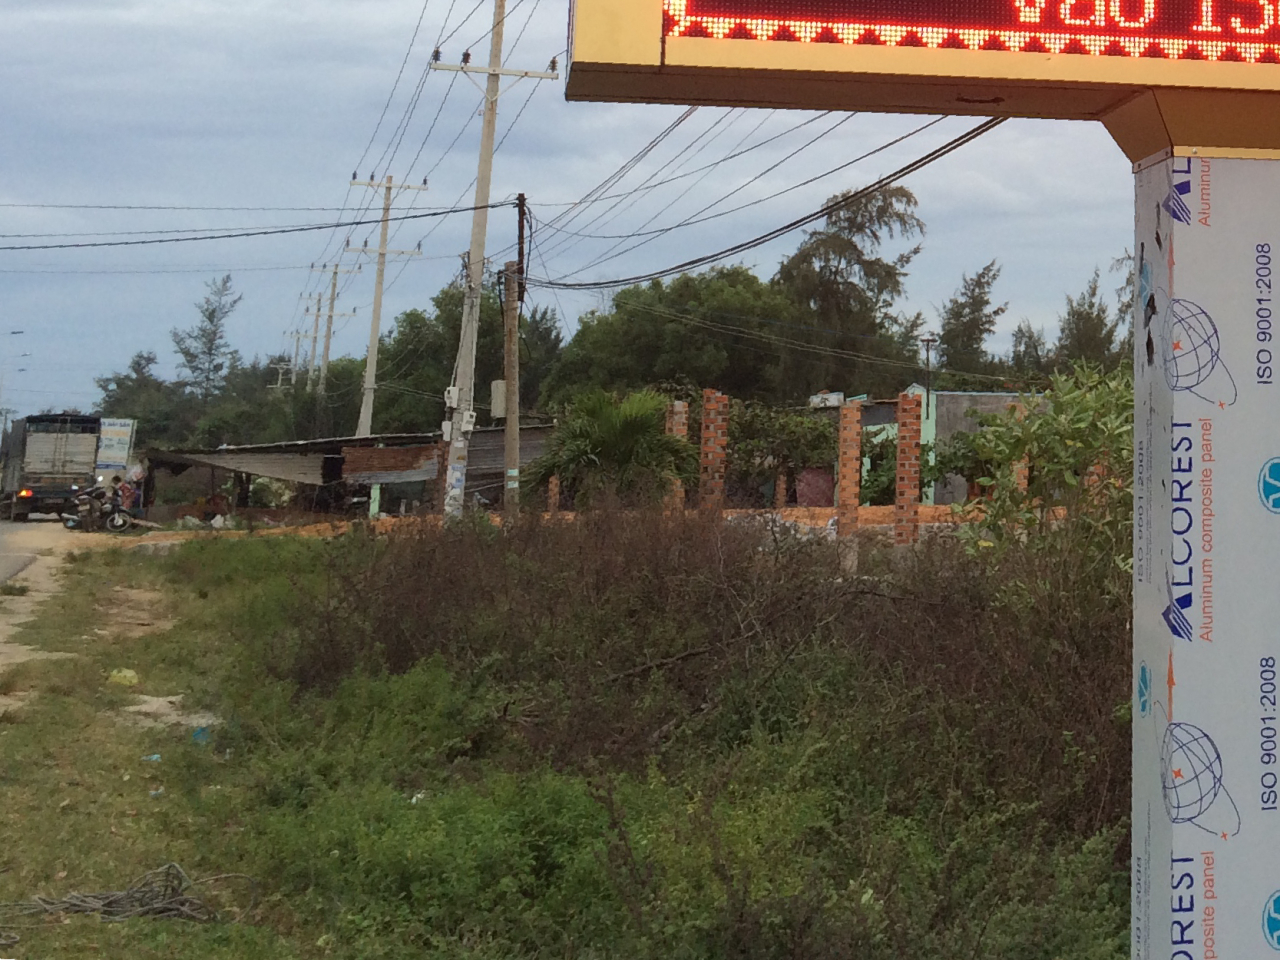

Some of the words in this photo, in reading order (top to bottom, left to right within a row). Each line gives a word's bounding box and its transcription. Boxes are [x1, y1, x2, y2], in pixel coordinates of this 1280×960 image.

[1256, 243, 1272, 342] 9001:2008
[1256, 349, 1272, 384] ISO
[1198, 418, 1215, 463] panel
[1162, 416, 1193, 642] ALCOREST
[1199, 468, 1215, 553] composite
[1199, 558, 1213, 643] Aluminum
[1260, 656, 1276, 765] 9001:2008
[1261, 772, 1277, 811] ISO
[1200, 851, 1217, 900] panel
